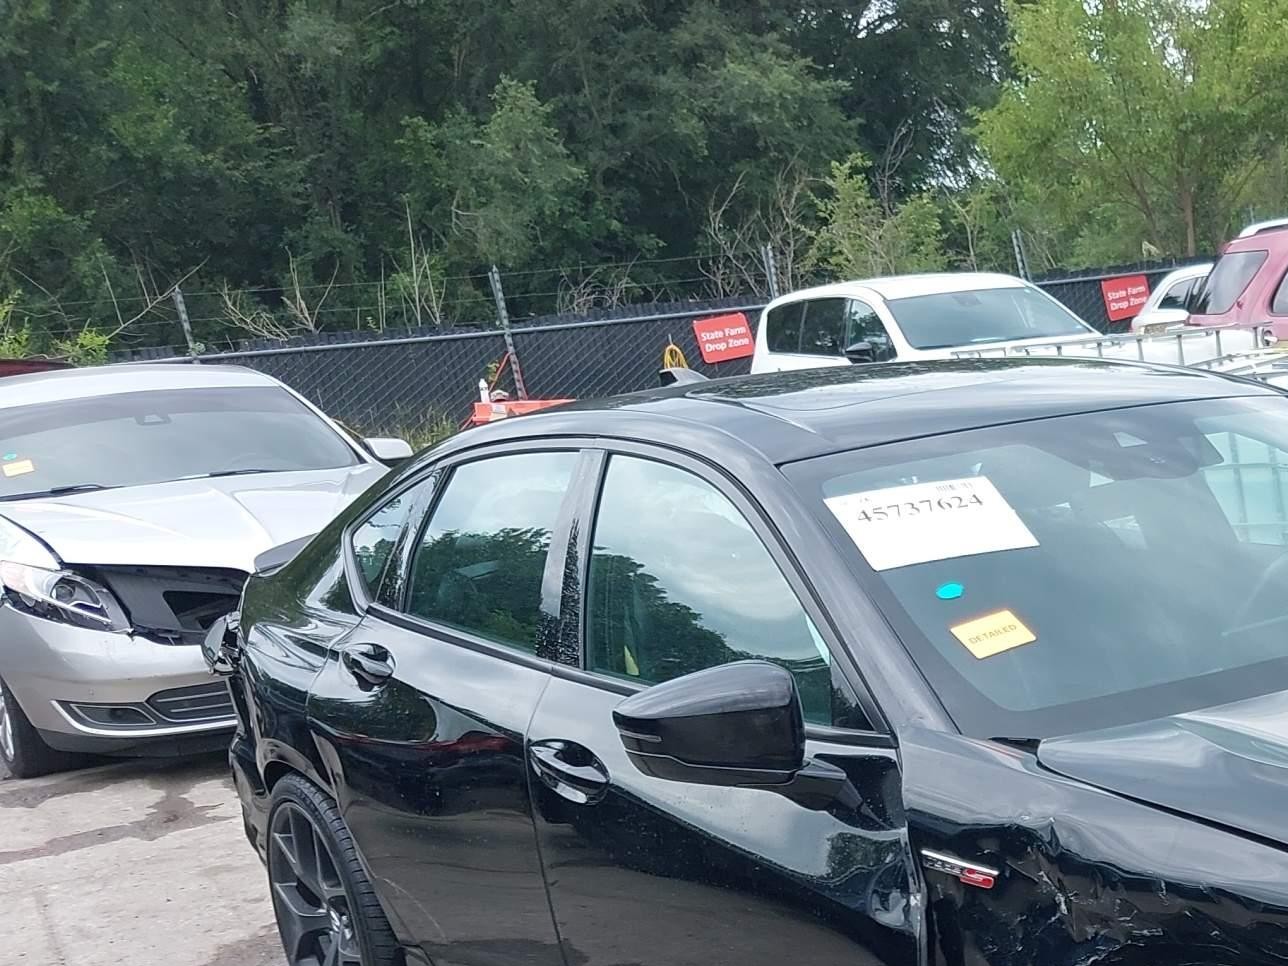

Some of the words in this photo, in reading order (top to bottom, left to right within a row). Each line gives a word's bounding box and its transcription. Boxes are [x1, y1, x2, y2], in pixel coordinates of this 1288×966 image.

[1108, 290, 1127, 300] State
[1127, 286, 1146, 295] Farm
[1110, 301, 1129, 311] Drop
[1129, 296, 1147, 306] Zone
[701, 331, 724, 341] State
[724, 327, 746, 336] Farm
[705, 342, 727, 352] Drop
[728, 338, 749, 347] Zone
[857, 494, 984, 521] 45737624
[968, 624, 1017, 644] DETAILED
